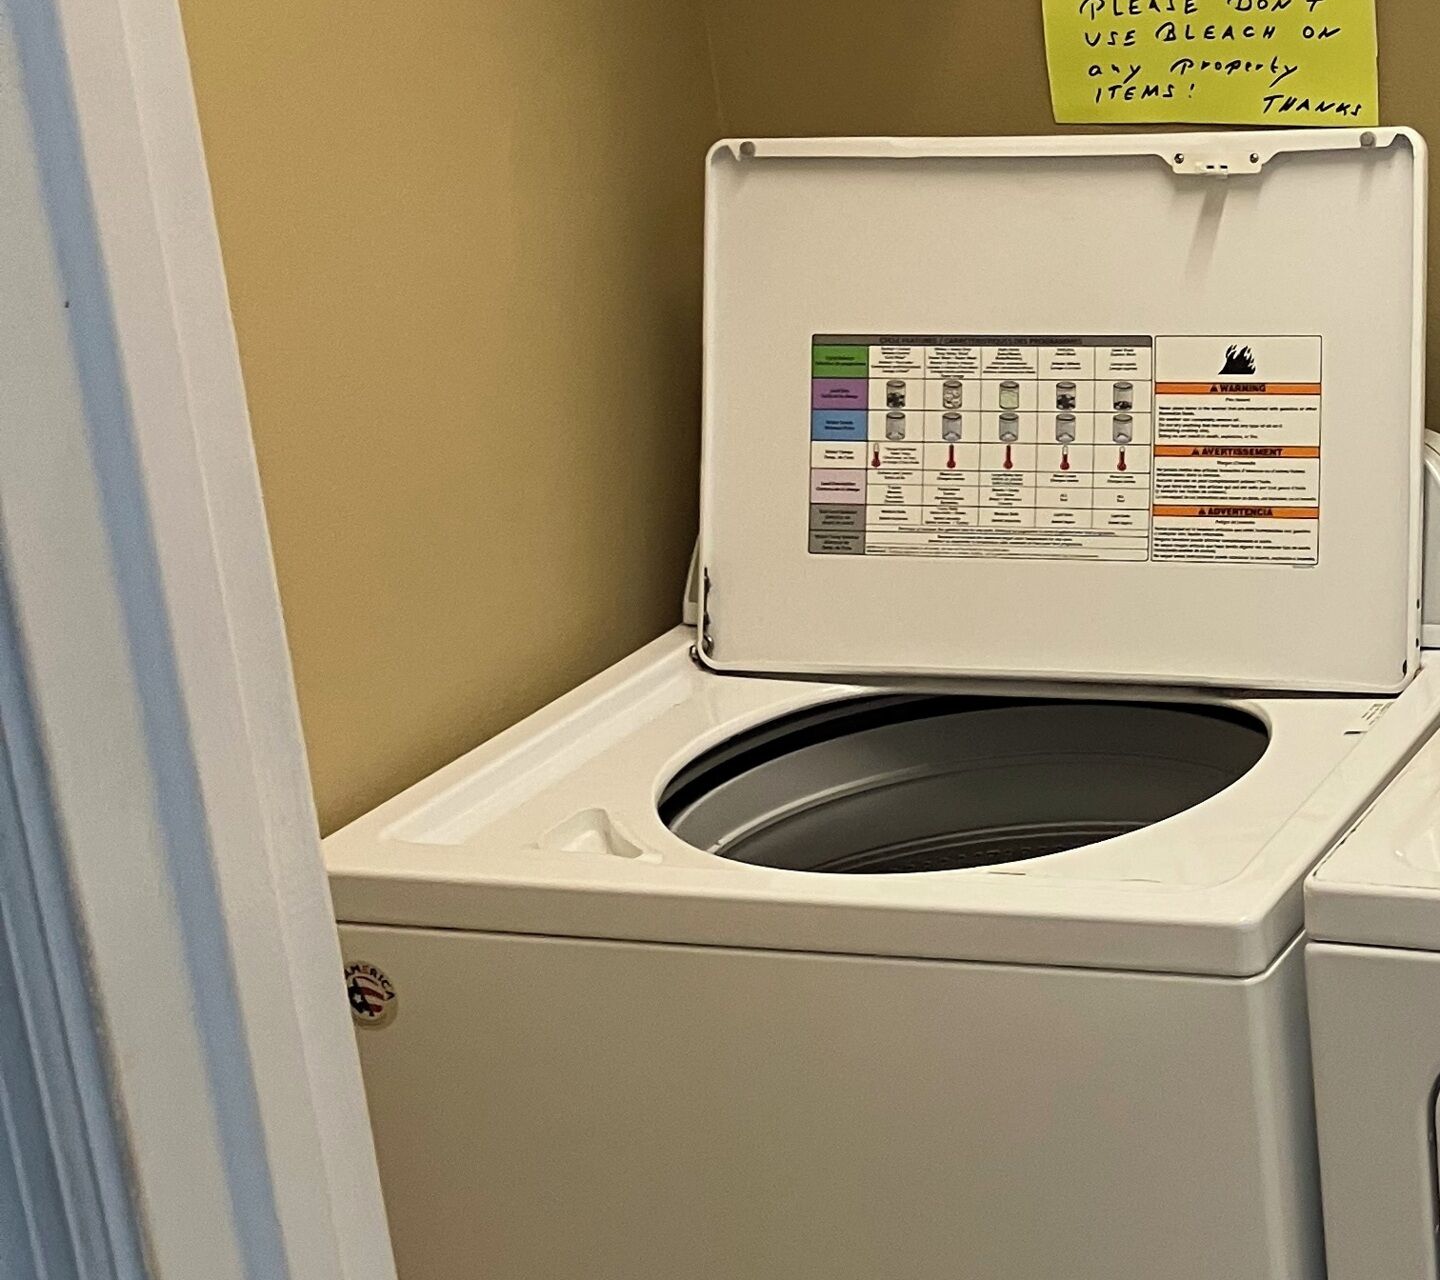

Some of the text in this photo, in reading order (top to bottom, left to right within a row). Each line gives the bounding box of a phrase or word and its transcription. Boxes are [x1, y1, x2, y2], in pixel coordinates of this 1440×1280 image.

[1085, 21, 1342, 47] USE BLEACH ON
[1088, 63, 1142, 84] any
[1263, 93, 1362, 117] THANKS
[1220, 384, 1267, 393] WARNING
[1202, 447, 1283, 457] AVERTISSEMENT
[1207, 507, 1274, 517] ADVERTENCIA
[344, 964, 396, 1001] MERICA
